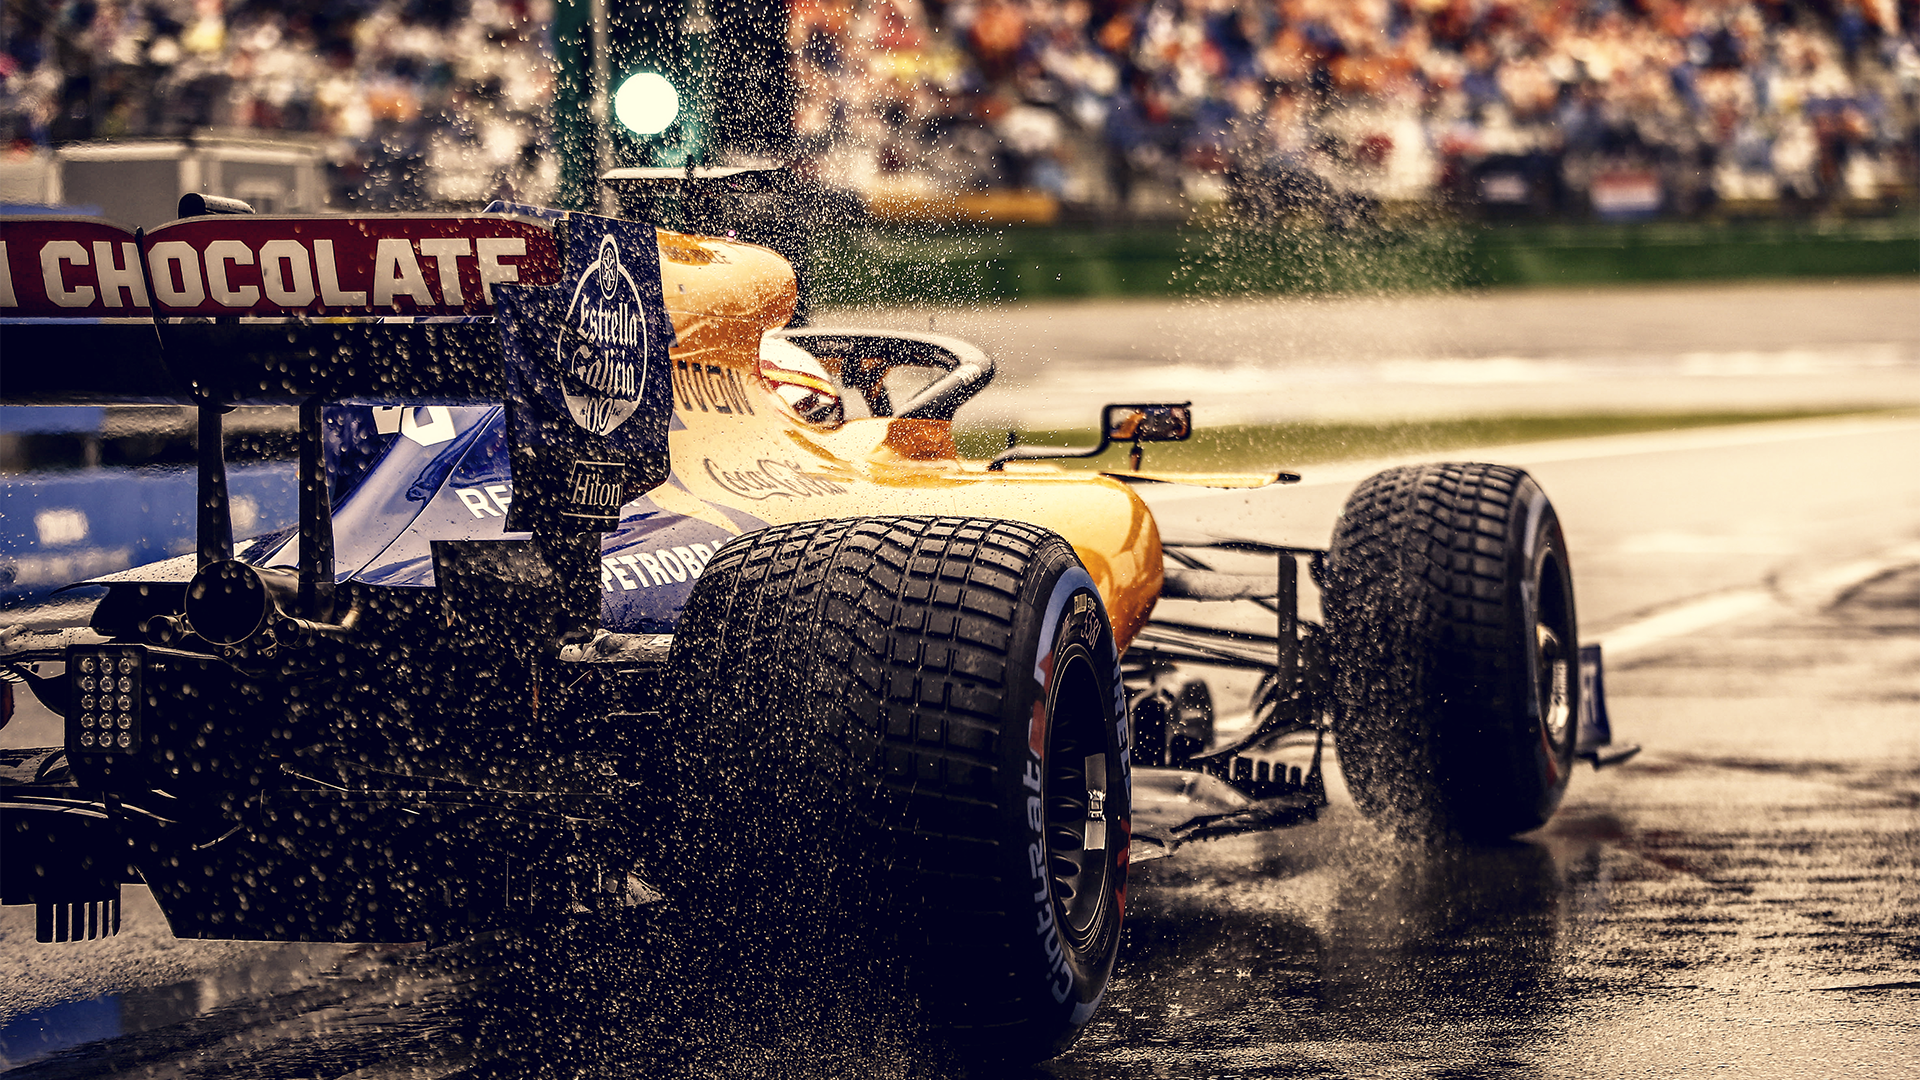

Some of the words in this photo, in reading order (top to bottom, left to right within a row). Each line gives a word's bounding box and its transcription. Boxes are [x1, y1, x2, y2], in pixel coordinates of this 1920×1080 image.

[39, 238, 527, 308] CHOCOLATE
[576, 293, 639, 347] Estrella
[570, 345, 637, 397] Galicia
[702, 454, 849, 501] Coca-Cola
